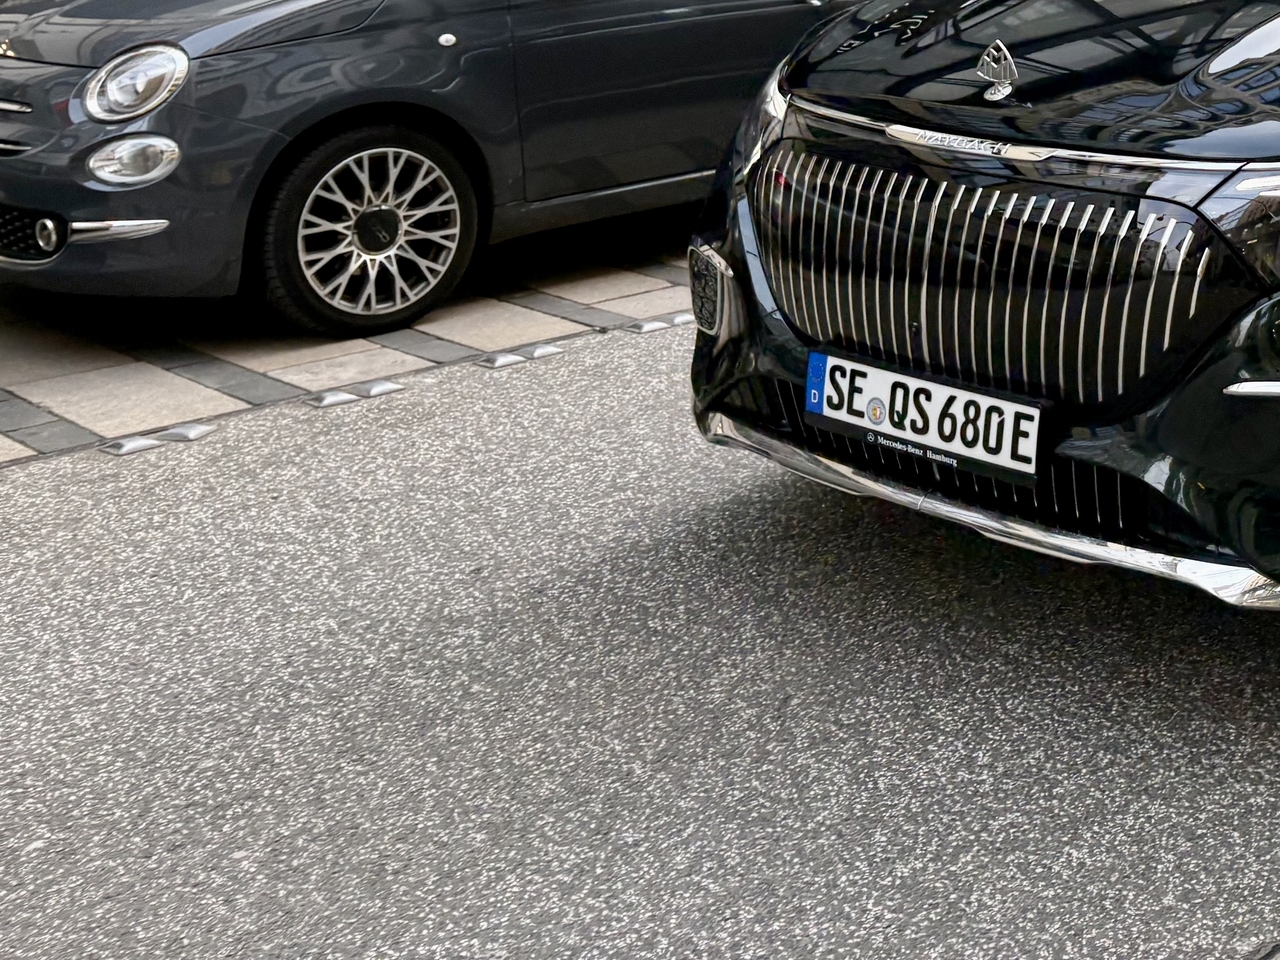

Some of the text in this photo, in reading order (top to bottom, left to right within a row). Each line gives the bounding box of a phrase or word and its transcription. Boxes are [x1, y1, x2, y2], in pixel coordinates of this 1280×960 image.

[916, 130, 1012, 155] MAYBACH
[811, 364, 1035, 465] D SE QS 680E
[877, 436, 958, 467] Mercedes-Benz Hamburg
